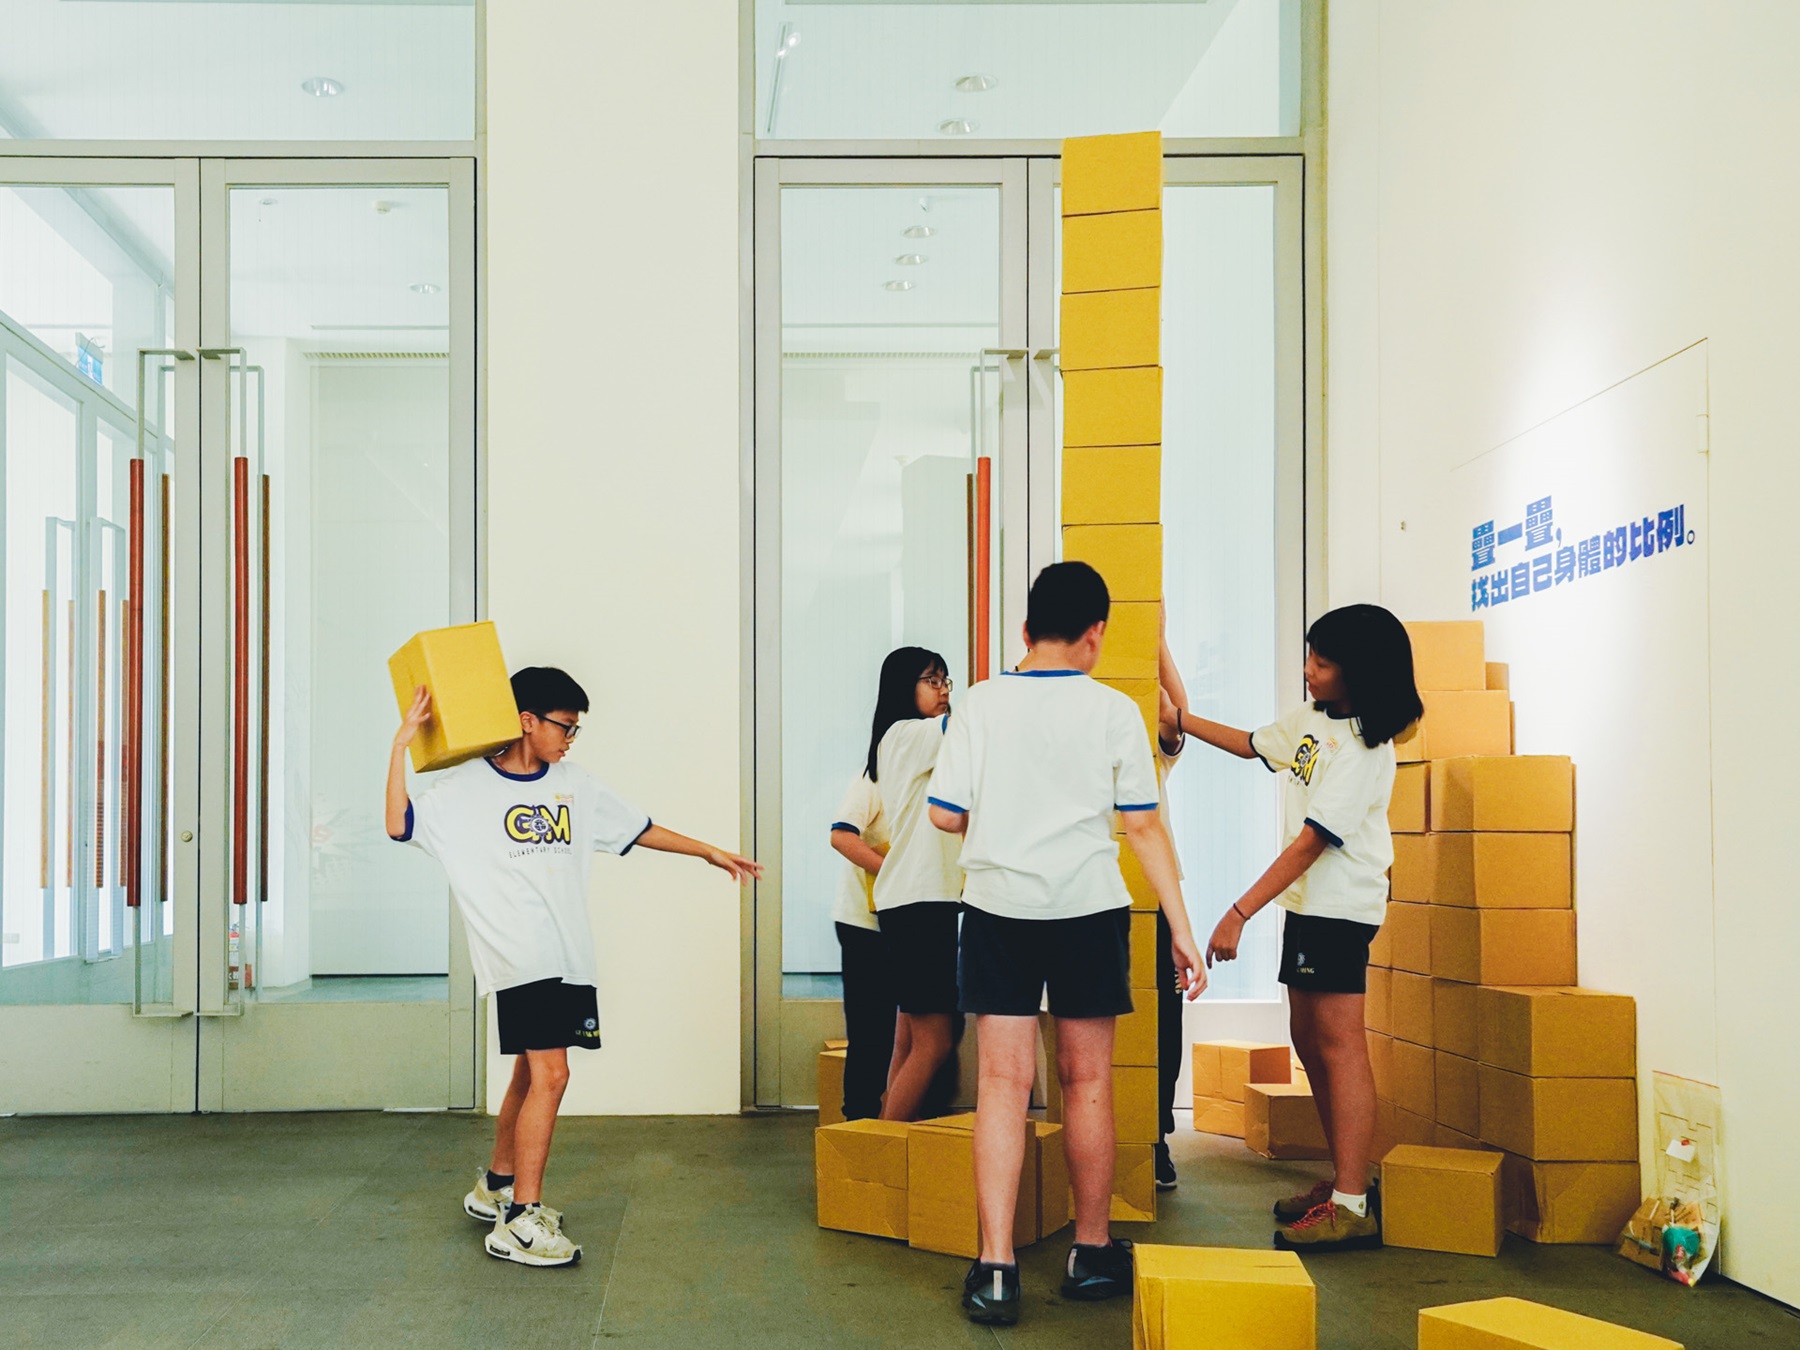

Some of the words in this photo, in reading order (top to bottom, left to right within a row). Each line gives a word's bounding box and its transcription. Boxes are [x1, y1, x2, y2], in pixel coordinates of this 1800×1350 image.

[1471, 504, 1695, 612] 找出自己身體的比例。
